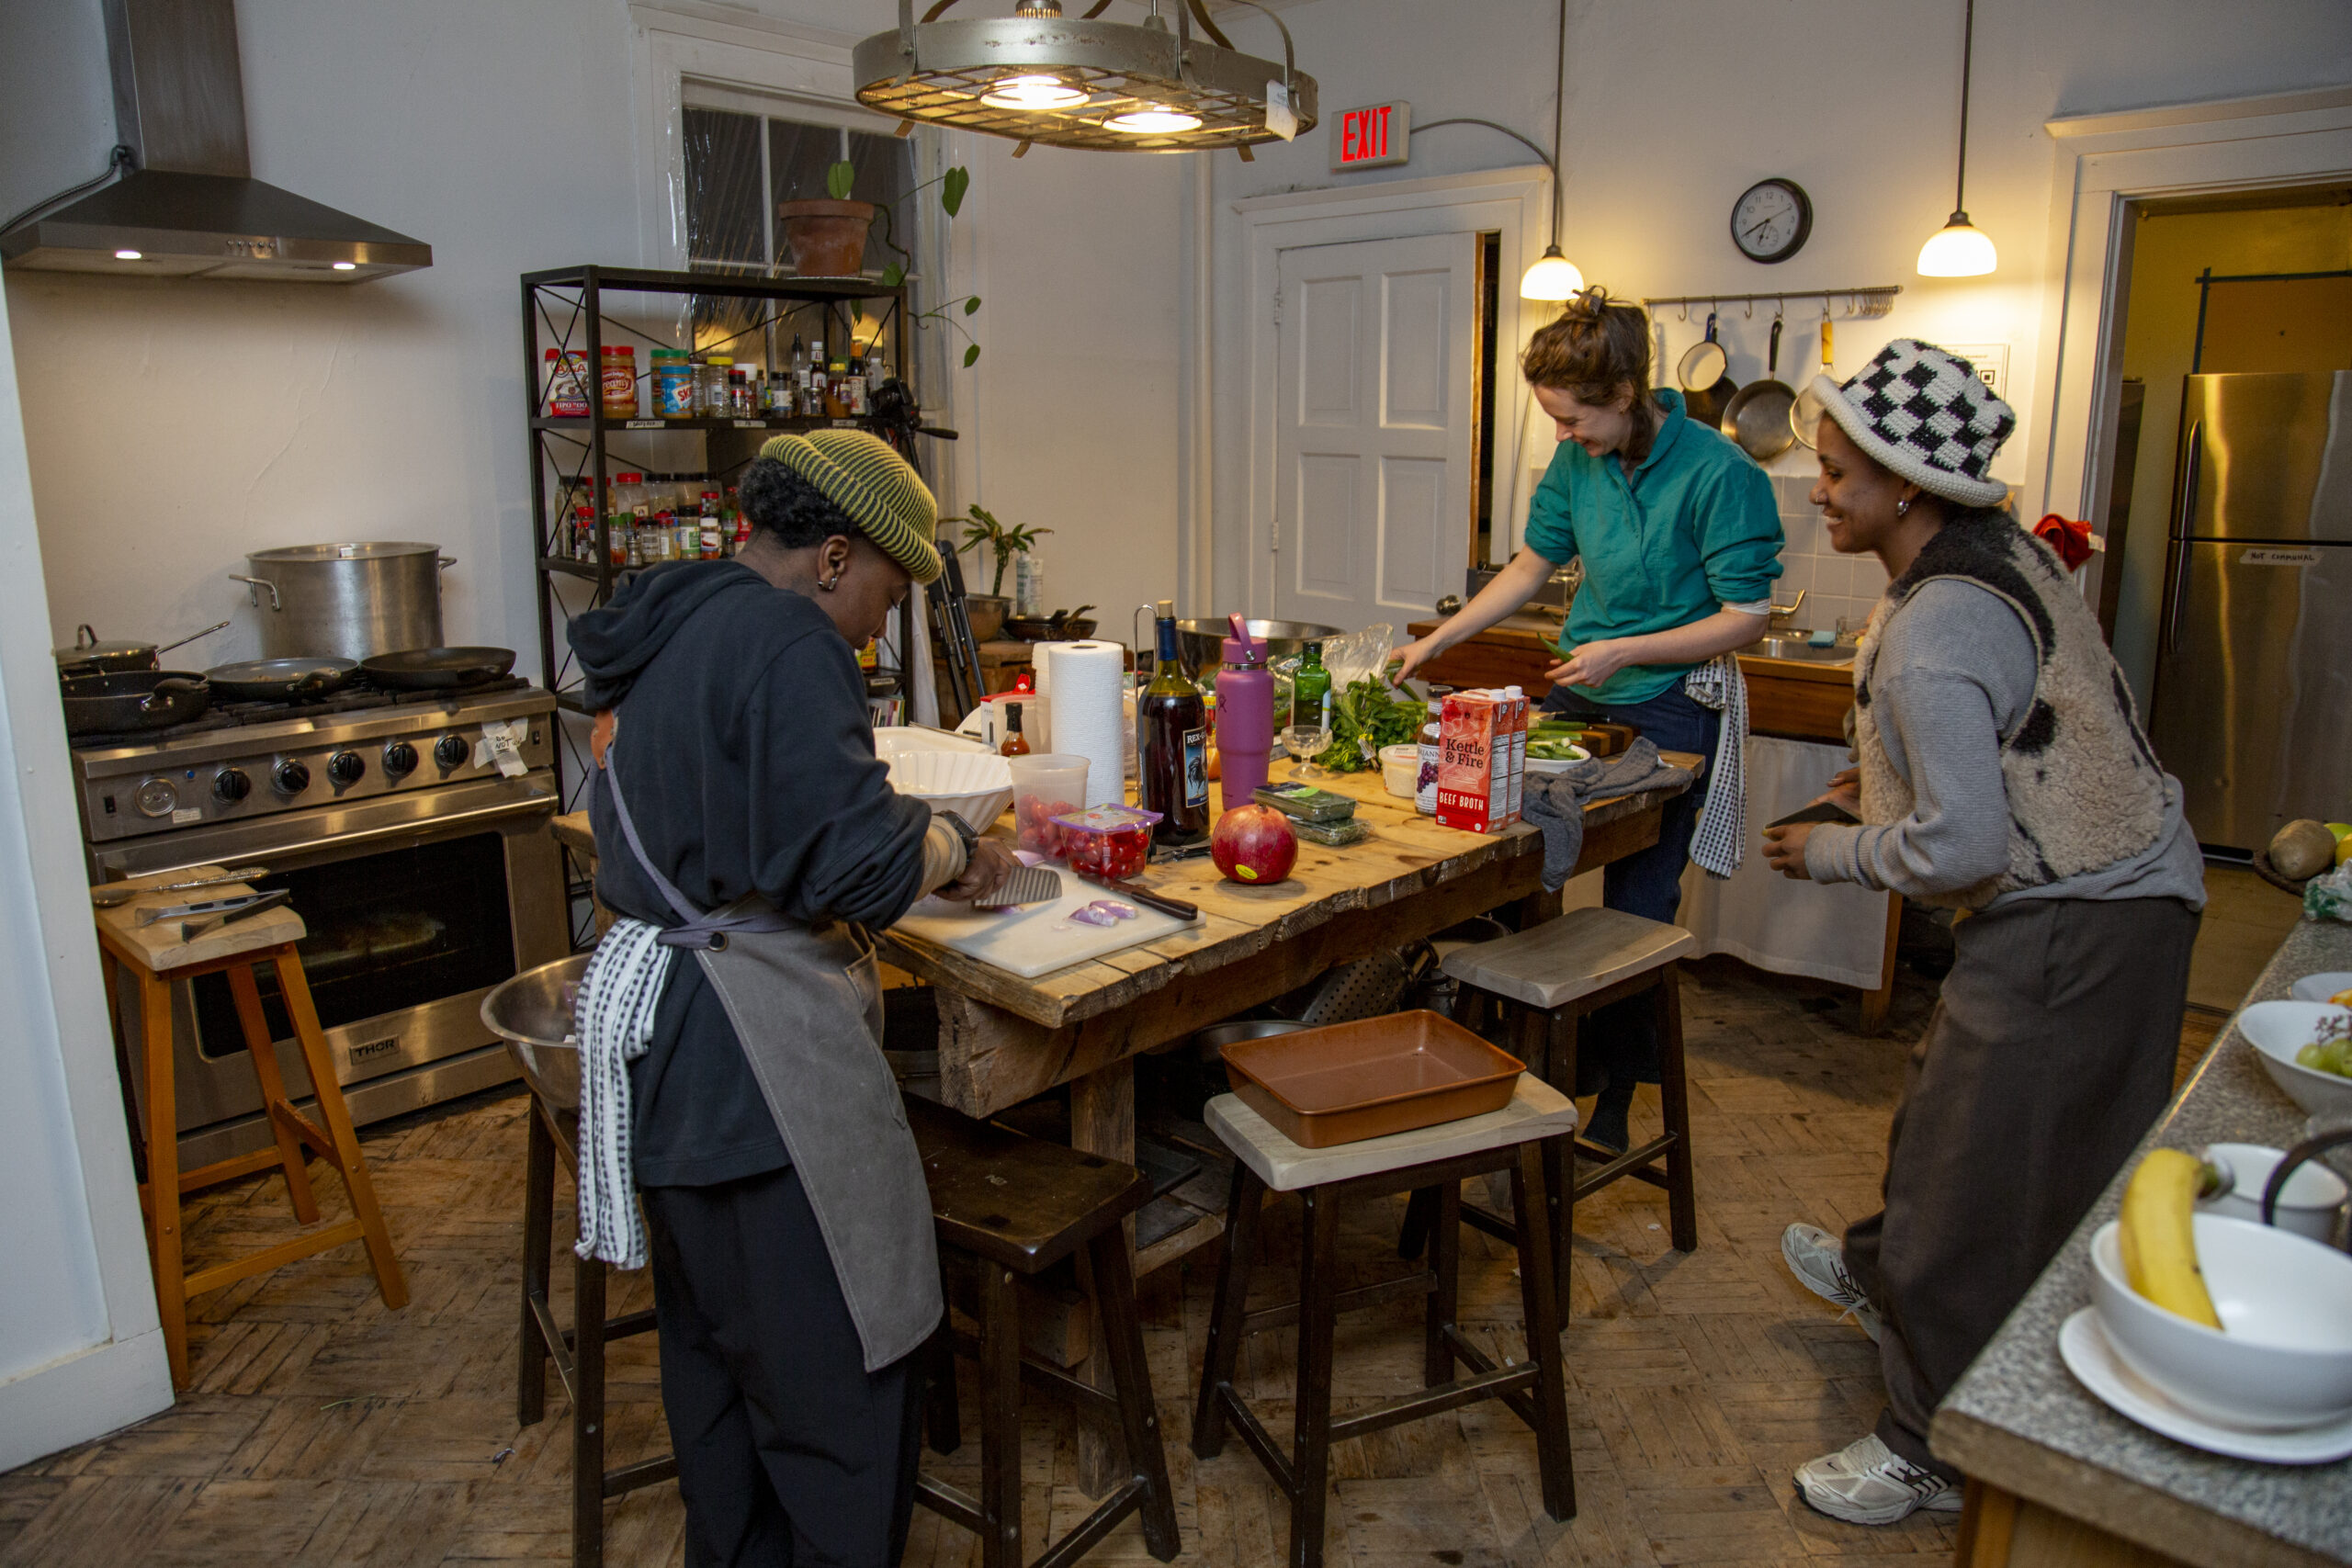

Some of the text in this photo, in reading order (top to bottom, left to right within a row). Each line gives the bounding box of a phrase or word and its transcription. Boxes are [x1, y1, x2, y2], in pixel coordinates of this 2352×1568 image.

[1342, 106, 1391, 163] EXIT
[1767, 191, 1773, 199] 12
[603, 378, 629, 390] reamy
[495, 738, 513, 748] NOT
[1445, 738, 1485, 756] Kettle
[1445, 751, 1484, 769] & Fire
[1439, 792, 1457, 805] BEEF
[1459, 794, 1484, 811] BROTH
[355, 1039, 395, 1056] THOR
